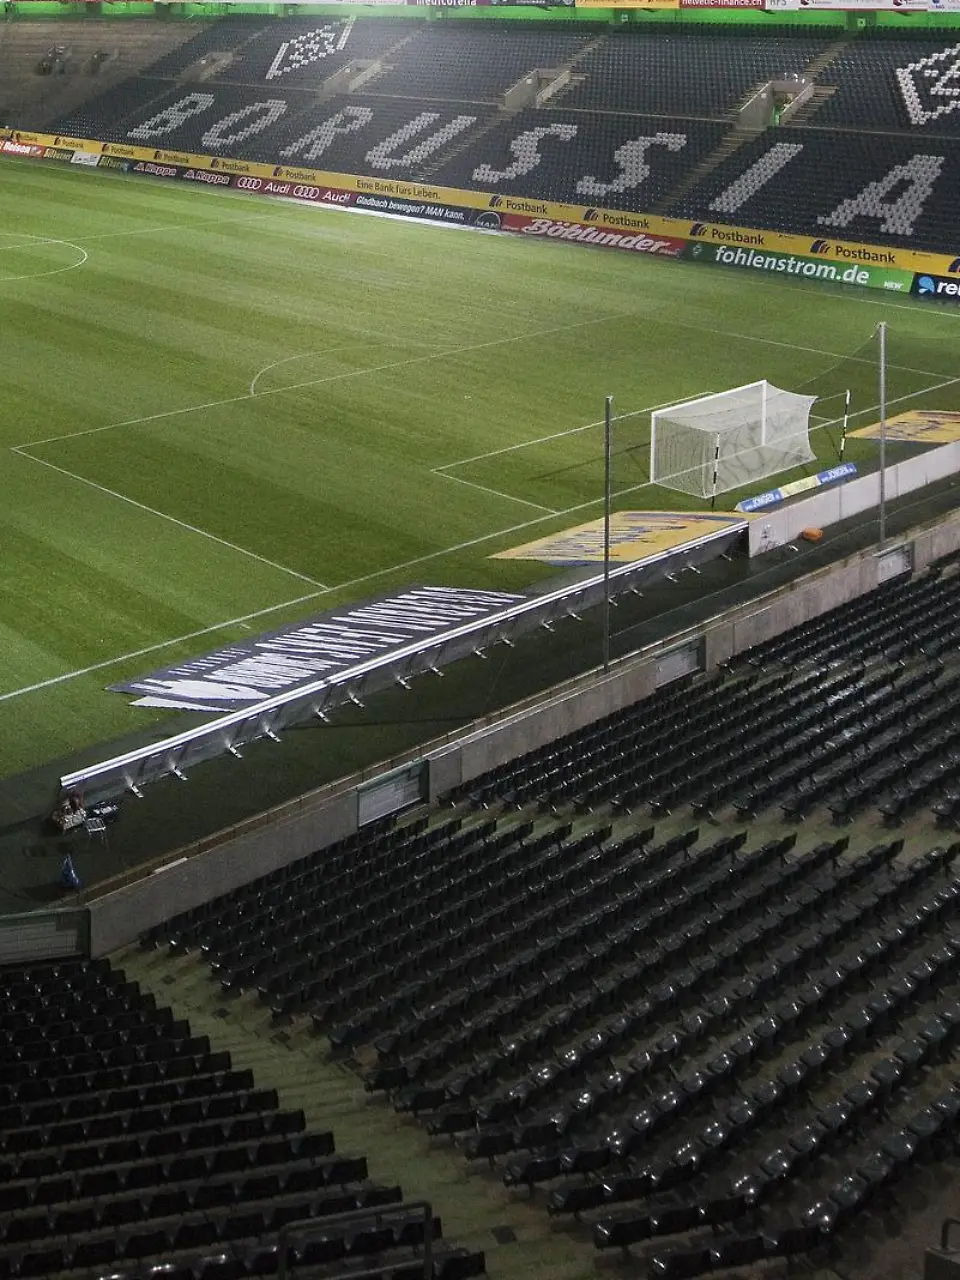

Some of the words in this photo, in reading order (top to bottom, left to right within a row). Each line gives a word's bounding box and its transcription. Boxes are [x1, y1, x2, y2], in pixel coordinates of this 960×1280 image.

[127, 92, 945, 236] BORUSSIA
[145, 161, 177, 176] Kappa
[222, 161, 250, 173] Postbank
[197, 170, 230, 185] Kappa
[285, 170, 317, 182] Postbank
[264, 181, 291, 194] Audi
[356, 179, 374, 190] Eine
[374, 182, 394, 193] Bank
[413, 188, 441, 200] Leben.
[322, 191, 351, 203] Audi
[356, 195, 388, 209] Gladbach
[388, 200, 425, 214] bewegen?
[425, 206, 444, 217] MAN
[444, 208, 465, 221] kann.
[506, 199, 548, 215] Postbank
[603, 213, 650, 230] Postbank
[521, 219, 672, 253] Böklunder
[711, 228, 765, 246] Postbank
[835, 245, 896, 265] Postbank
[715, 245, 870, 285] fohlenstrom.de
[937, 281, 960, 296] re
